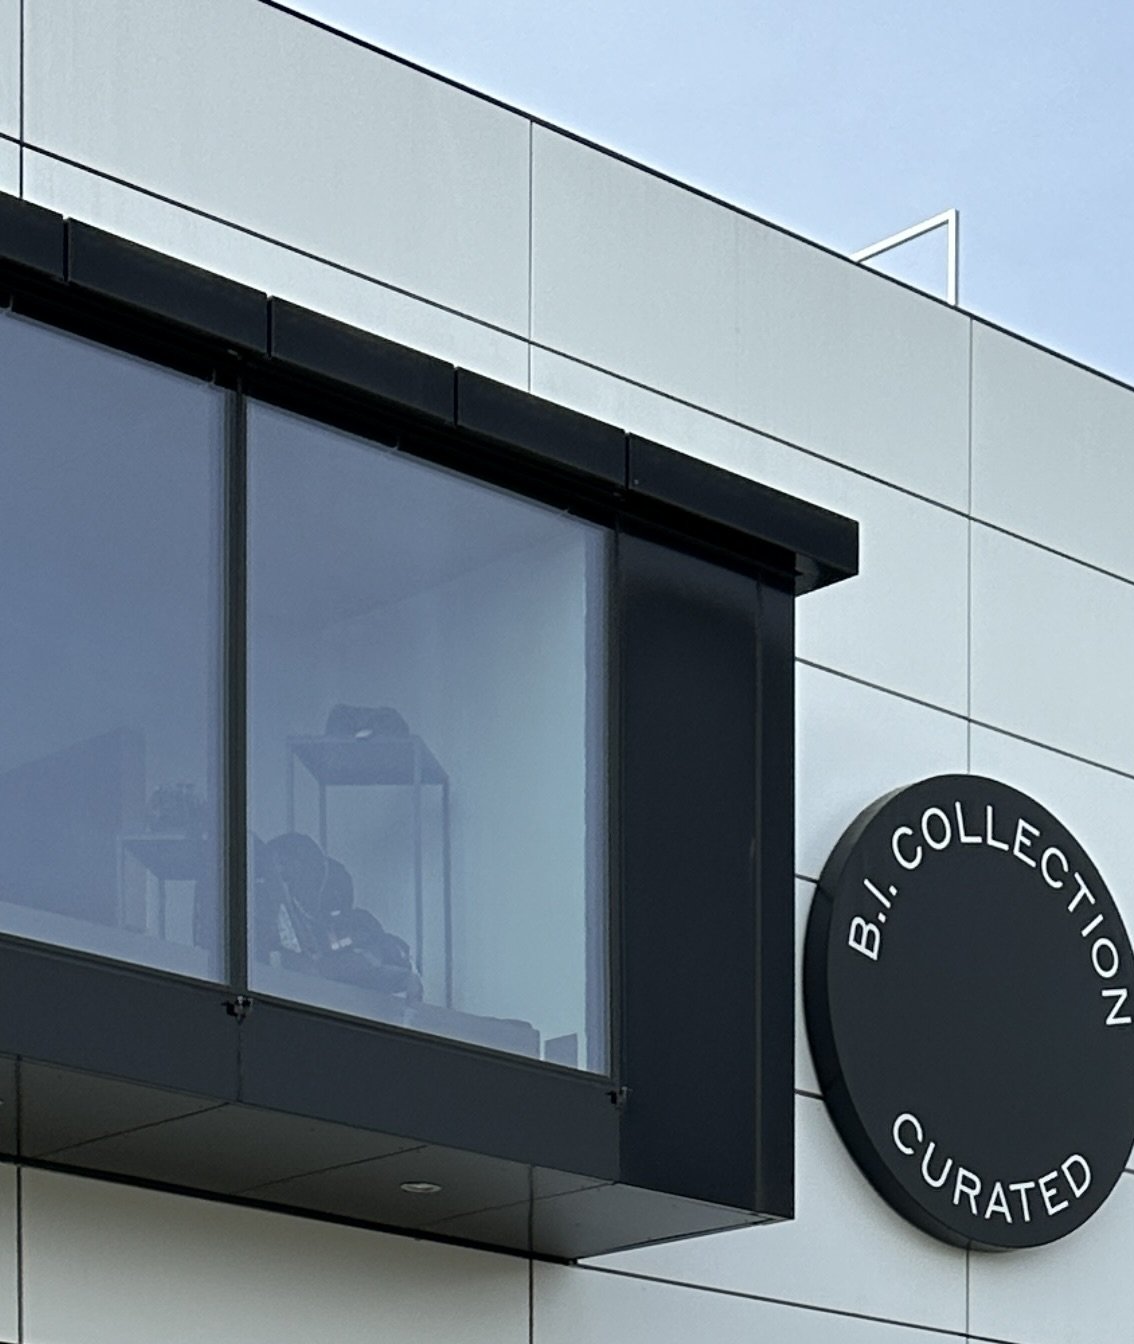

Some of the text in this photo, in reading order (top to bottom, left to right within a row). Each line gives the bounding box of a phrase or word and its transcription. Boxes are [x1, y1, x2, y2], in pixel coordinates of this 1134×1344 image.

[848, 800, 1133, 1026] B.I. COLLECTION
[892, 1112, 1093, 1225] CURATED
